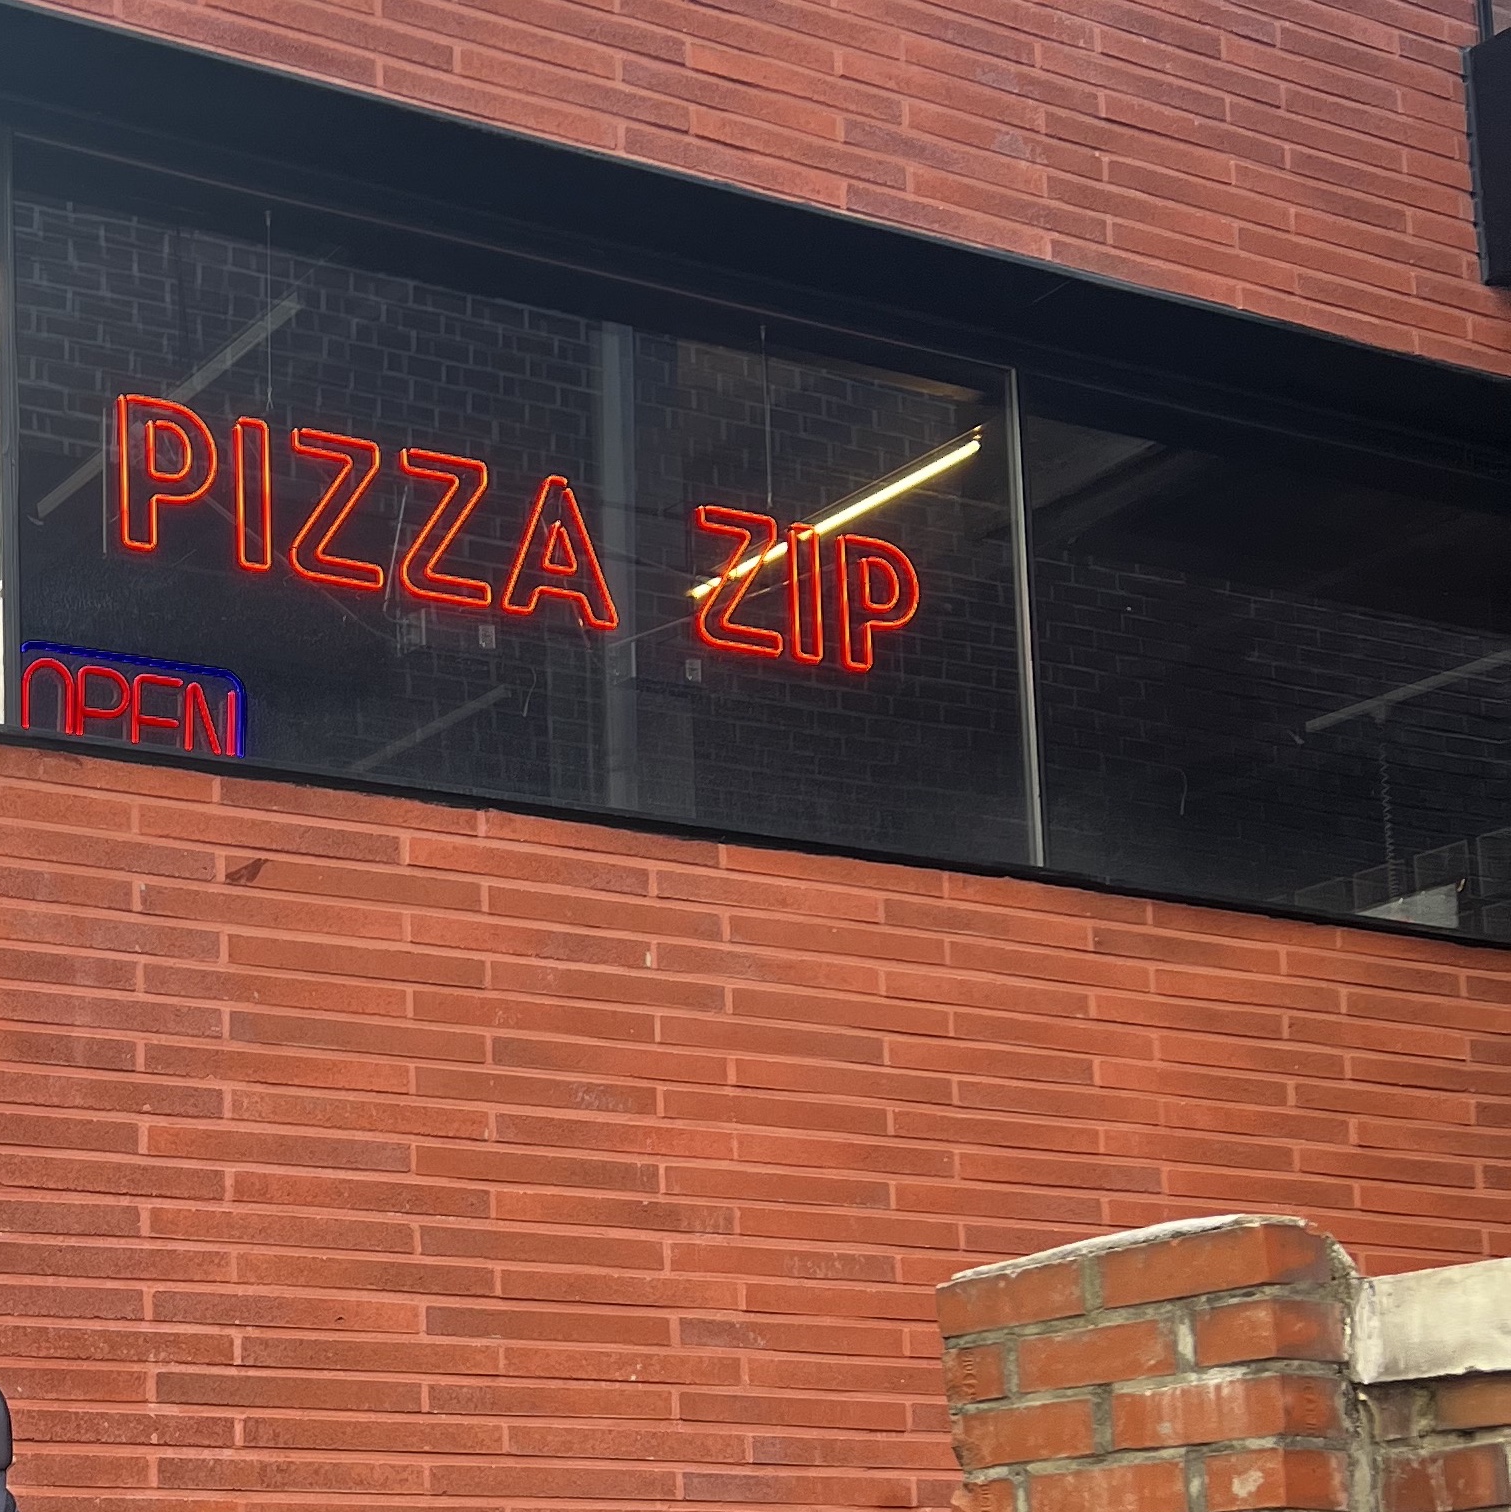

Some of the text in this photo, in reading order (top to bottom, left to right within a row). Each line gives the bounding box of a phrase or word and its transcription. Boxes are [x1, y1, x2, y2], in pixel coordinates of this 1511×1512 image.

[114, 393, 920, 672] PIZZA ZIP
[21, 657, 237, 757] OPEN
